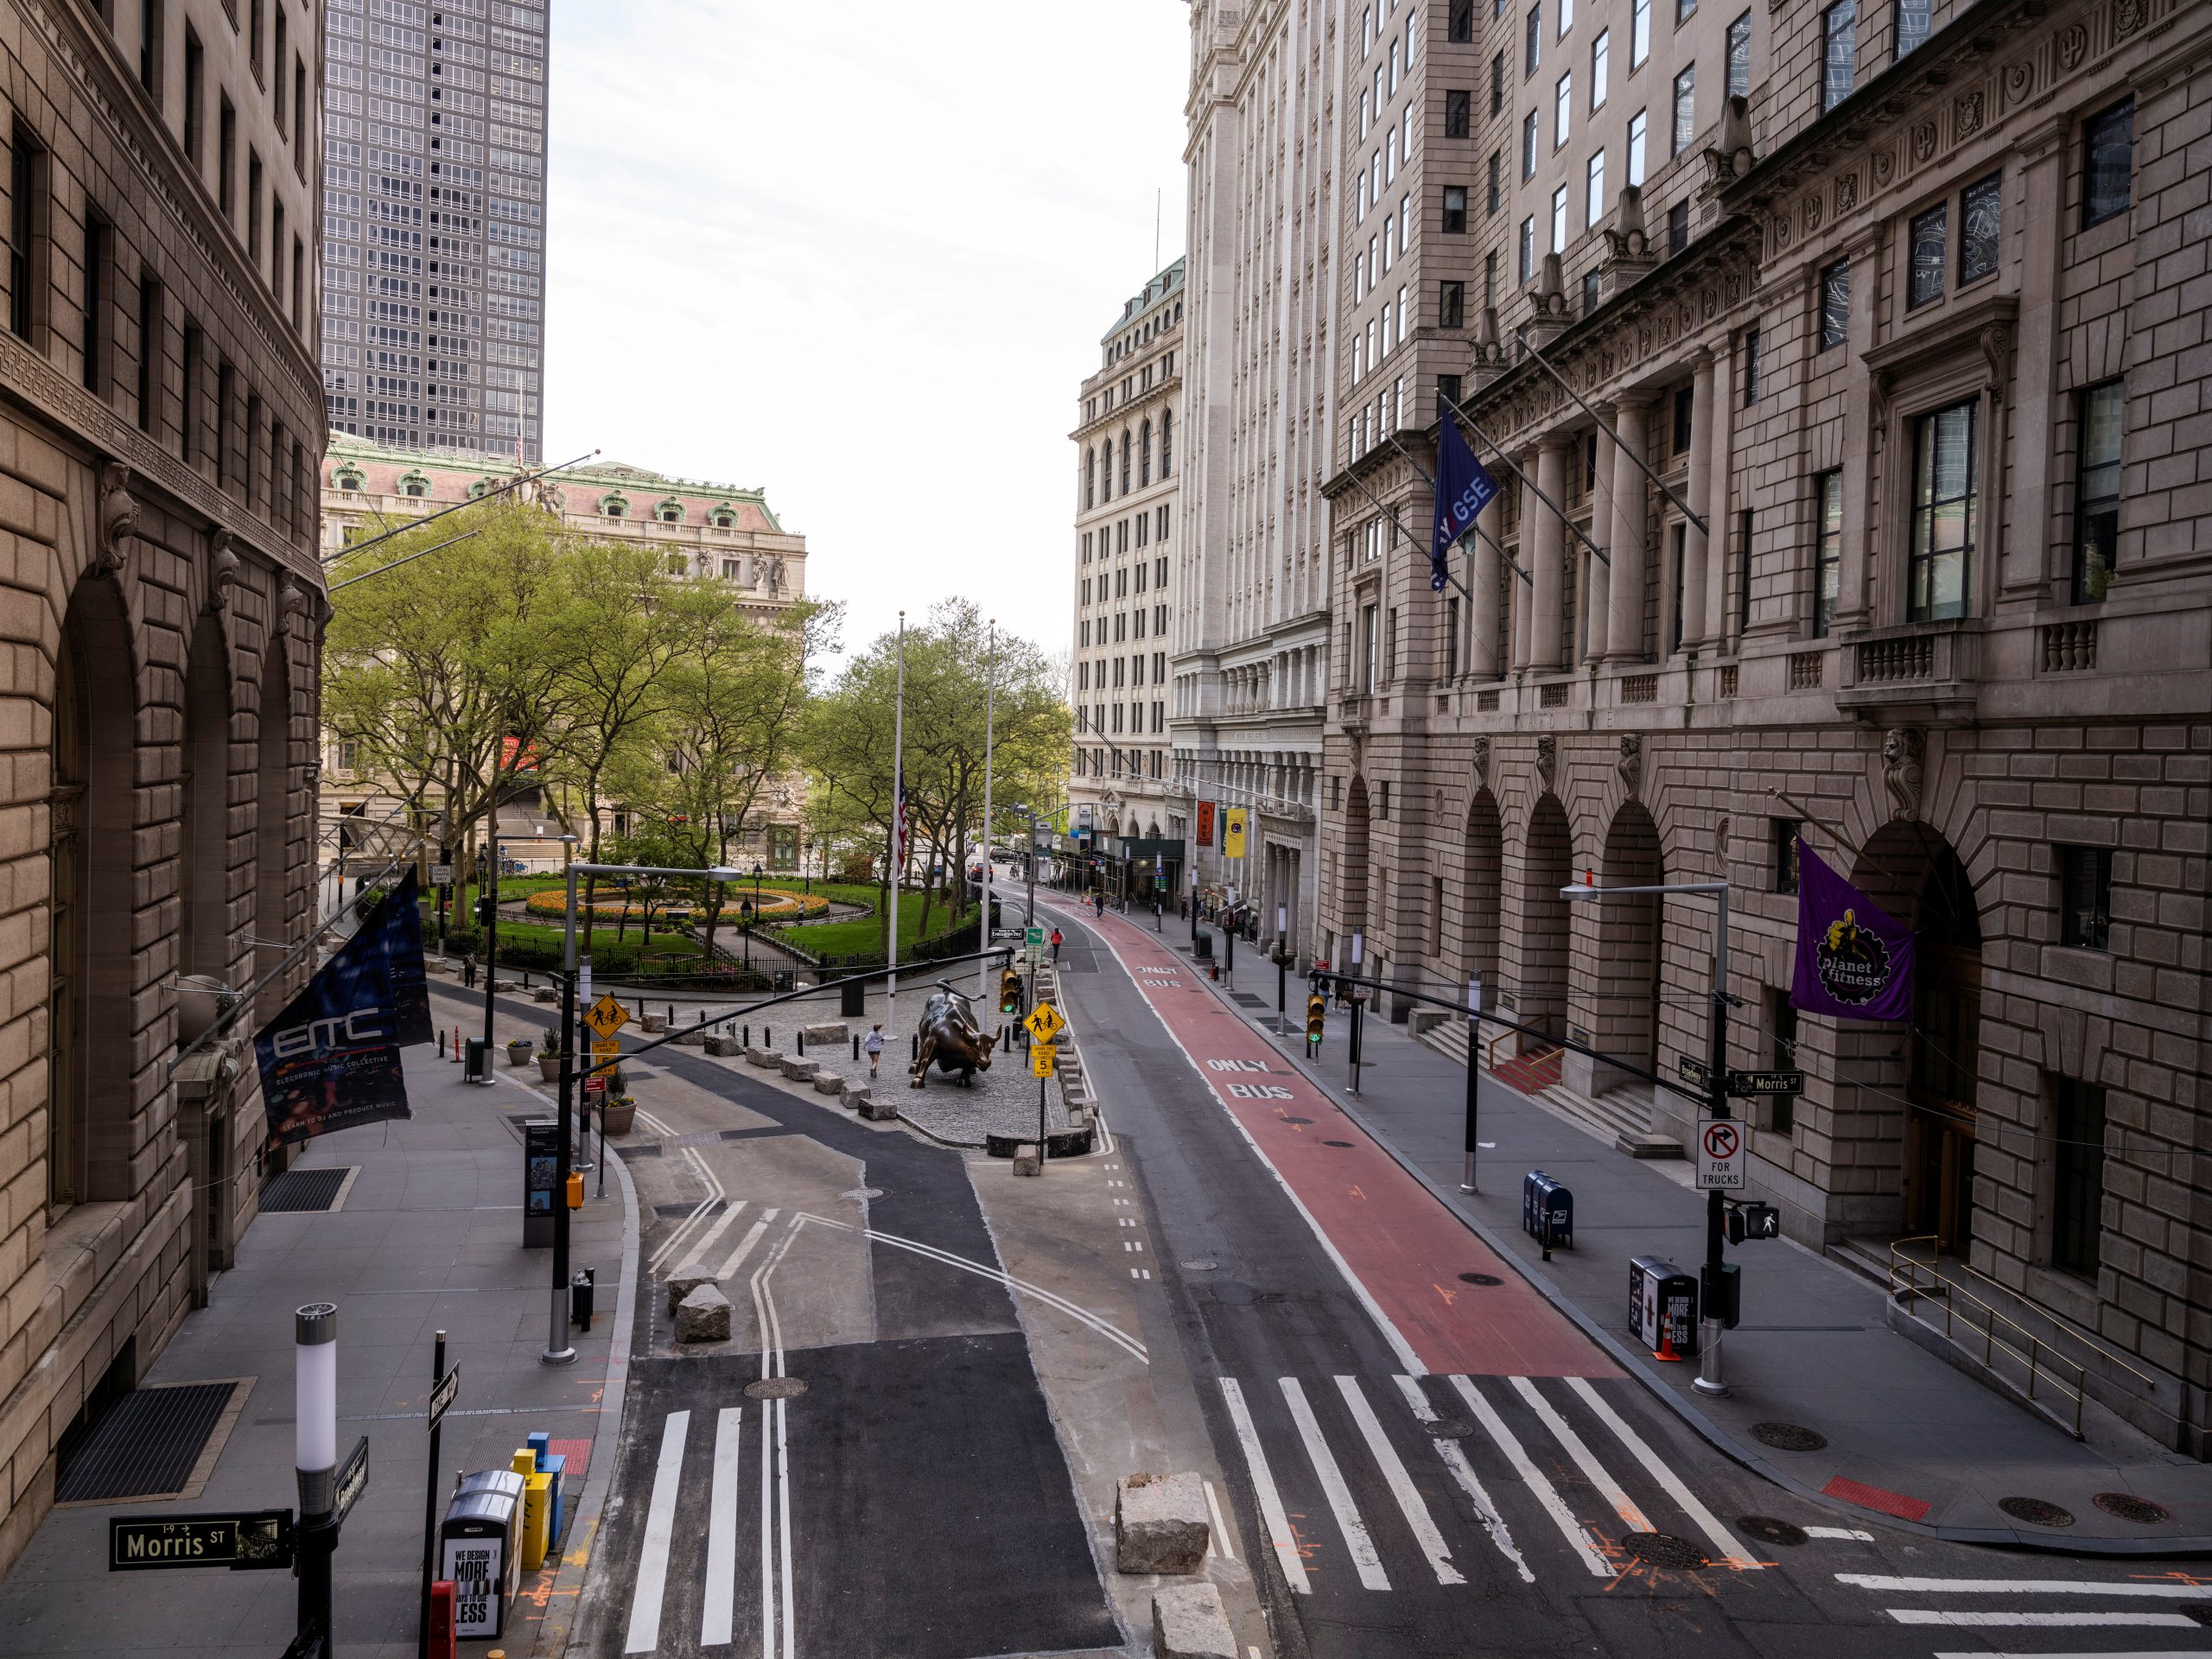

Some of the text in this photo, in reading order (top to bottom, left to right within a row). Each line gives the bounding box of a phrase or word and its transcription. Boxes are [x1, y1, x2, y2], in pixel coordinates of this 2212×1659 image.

[1452, 476, 1491, 522] GSE
[1821, 957, 1872, 974] planet
[1143, 979, 1182, 988] BUS
[1827, 969, 1883, 987] fitness
[276, 1055, 389, 1086] ELECTRONIC MUSIC COLLECTIVE
[1039, 1060, 1047, 1070] 5
[1205, 1059, 1272, 1072] ONLY
[1756, 1077, 1789, 1090] Morris
[1225, 1084, 1295, 1100] BUS
[283, 1100, 397, 1132] LEARN TO DJ AND PRODUCE MUSIC
[1711, 1162, 1730, 1172] FOR
[1702, 1174, 1739, 1185] TRUCKS
[1669, 1304, 1688, 1316] MORE
[1671, 1331, 1688, 1344] ESS
[434, 1392, 444, 1414] ONE
[127, 1530, 225, 1558] Morris ST
[455, 1550, 466, 1560] WE
[467, 1550, 490, 1560] DESIGN
[454, 1560, 489, 1582] MORE
[469, 1594, 476, 1603] TO
[477, 1593, 487, 1602] USE
